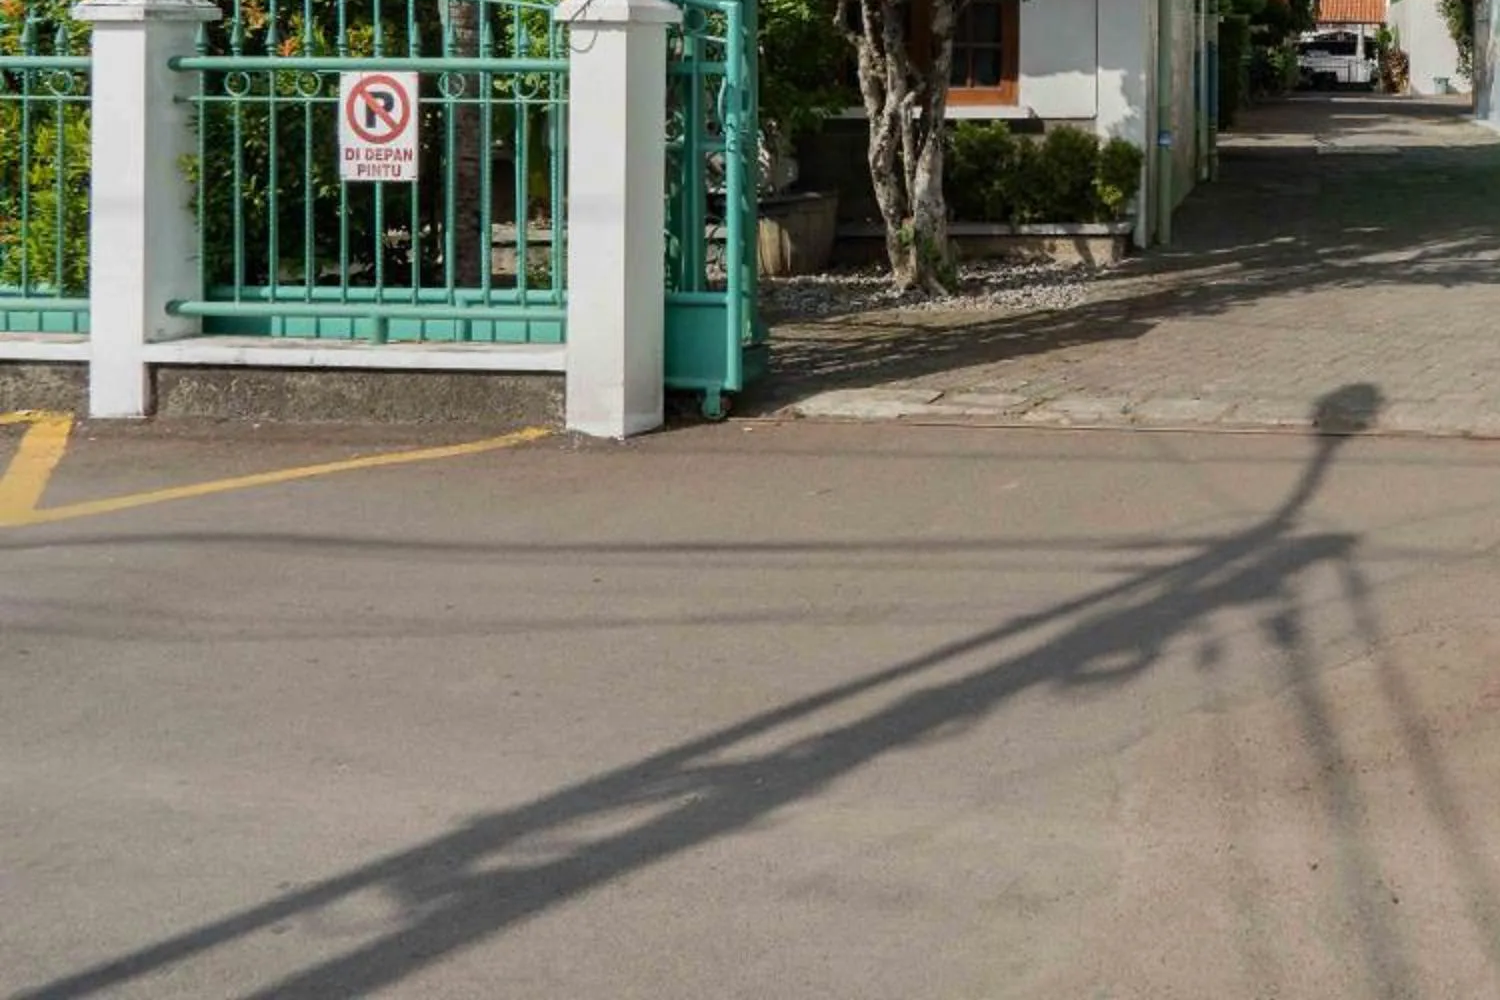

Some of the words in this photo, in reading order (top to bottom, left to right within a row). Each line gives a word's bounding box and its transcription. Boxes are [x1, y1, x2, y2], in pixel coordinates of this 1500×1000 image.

[365, 91, 395, 129] P
[345, 148, 360, 160] DI
[365, 148, 413, 160] DEPAN
[357, 164, 401, 177] PINTU
